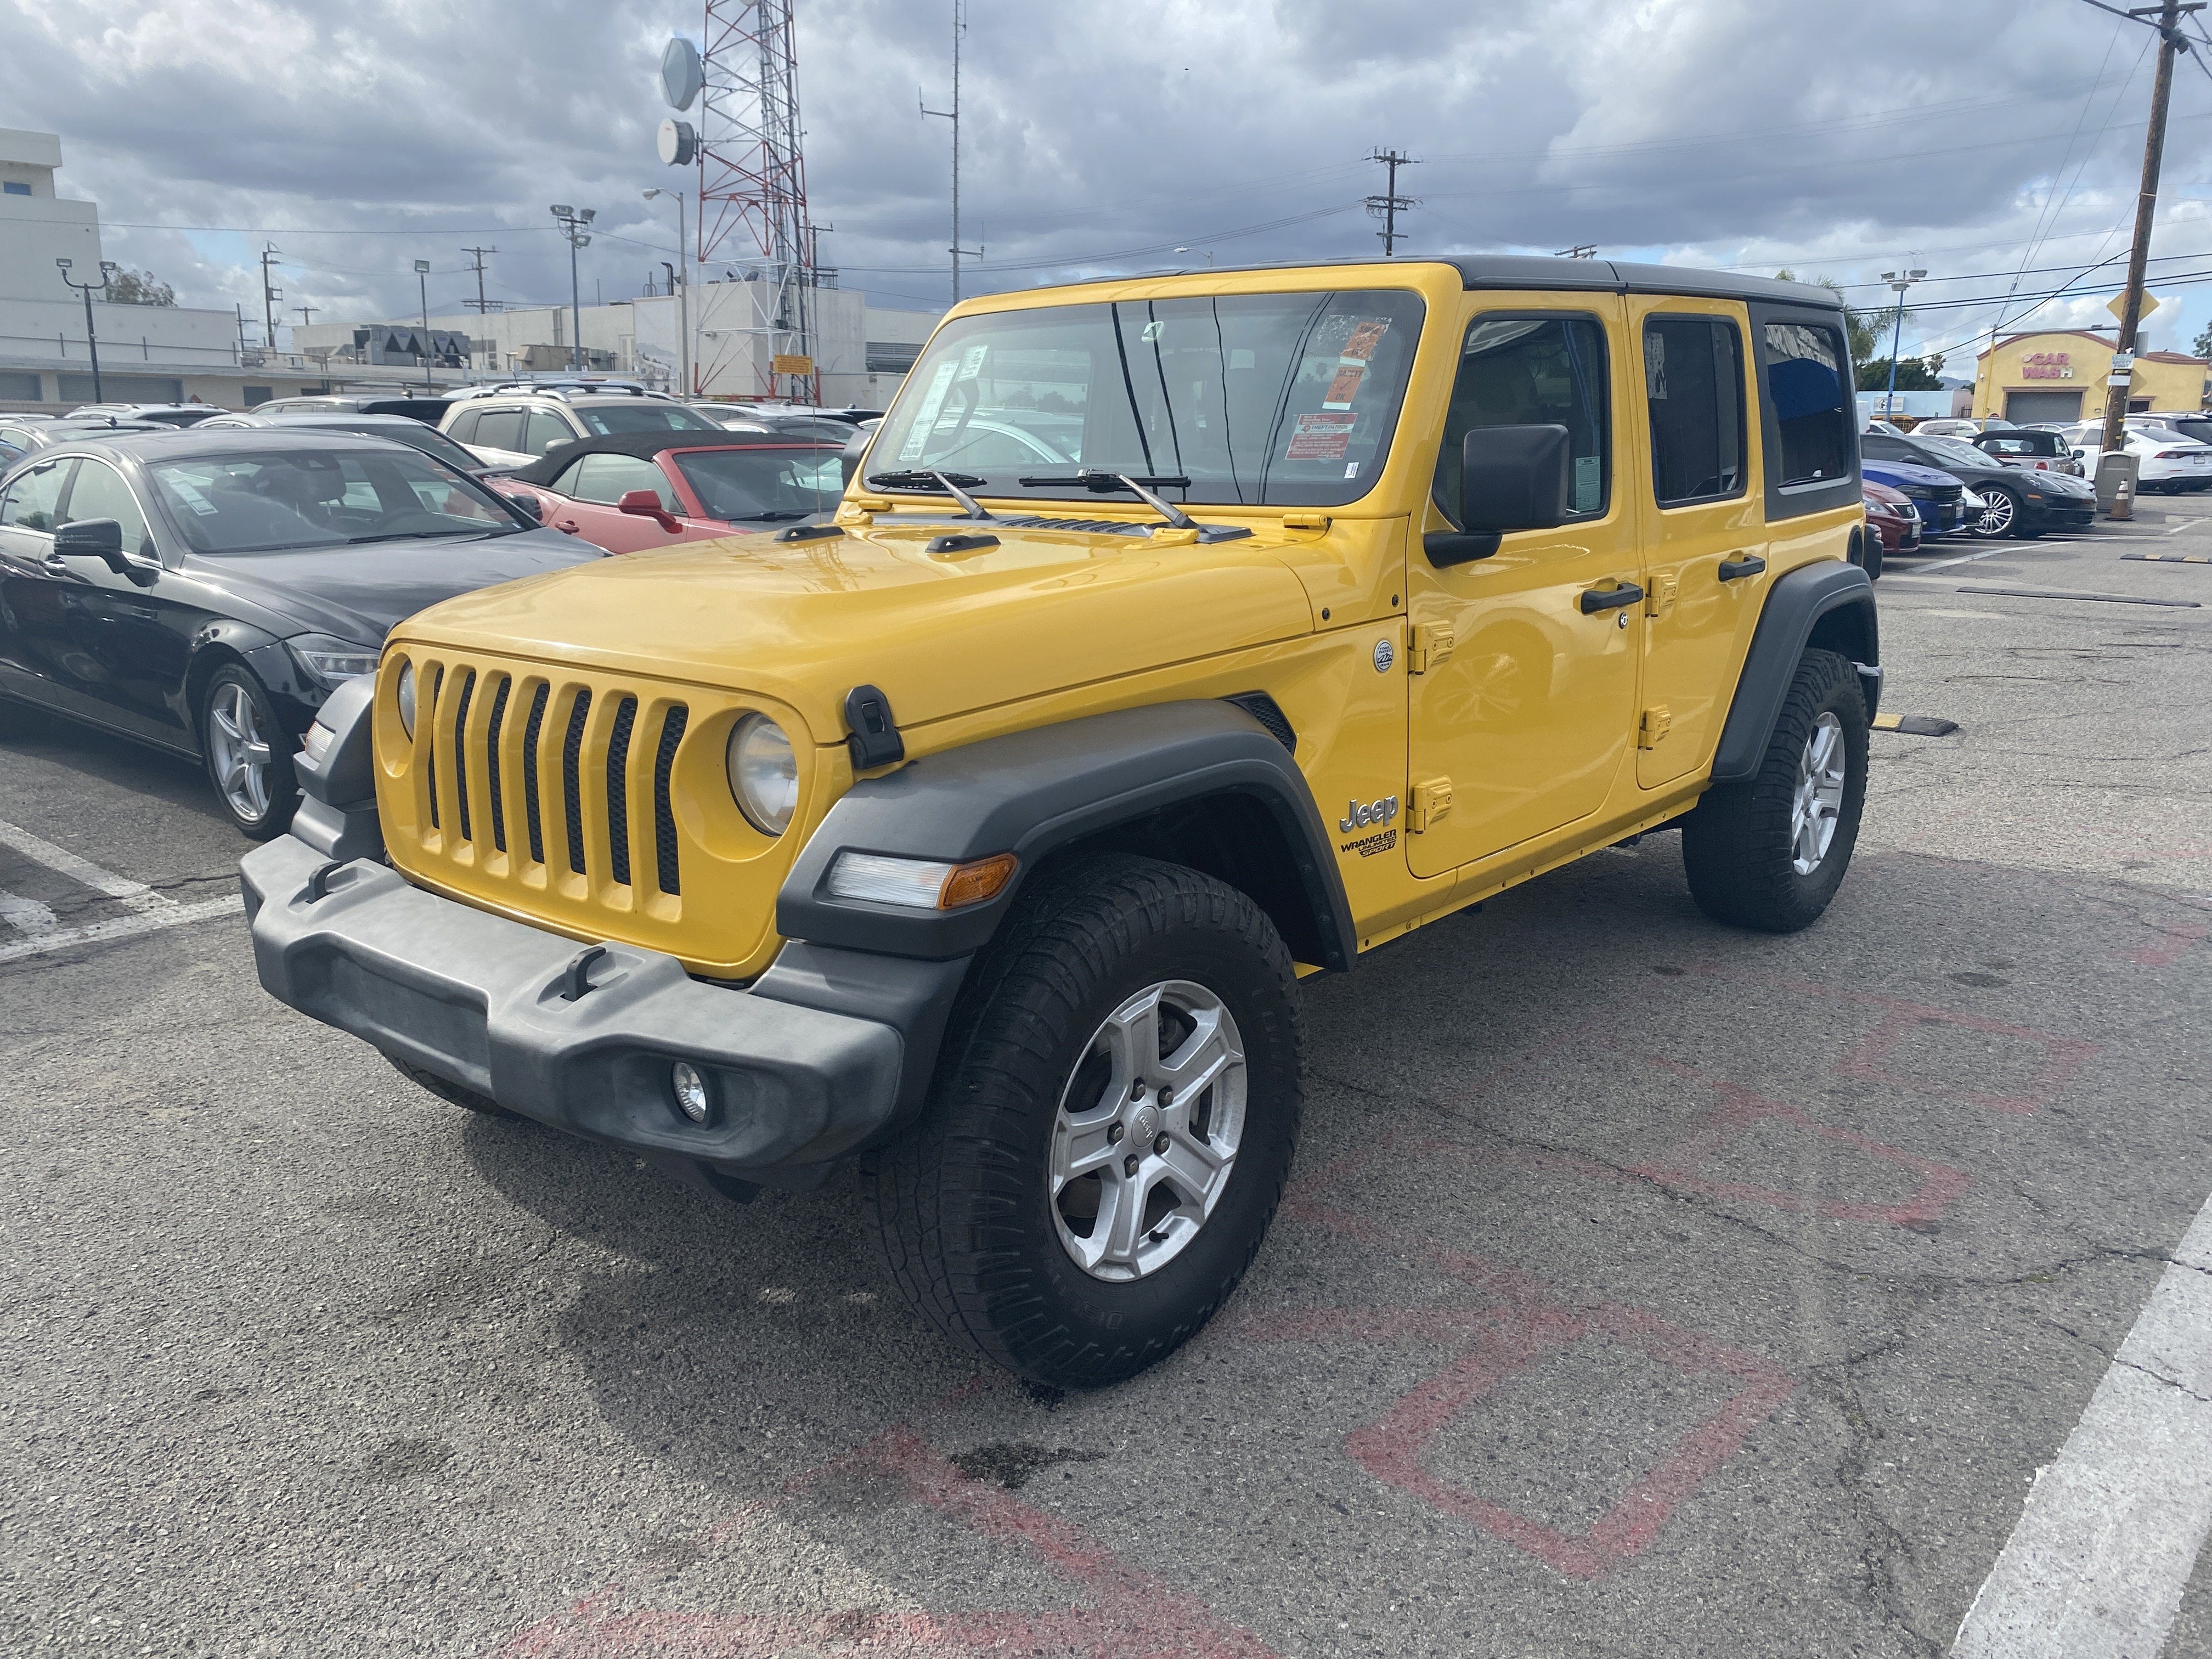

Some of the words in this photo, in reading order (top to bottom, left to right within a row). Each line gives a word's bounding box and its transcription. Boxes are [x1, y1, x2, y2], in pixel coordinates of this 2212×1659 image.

[2032, 353, 2068, 365] CAR
[1337, 370, 1364, 378] SAFETY
[2023, 366, 2073, 379] WASH
[1339, 795, 1398, 833] Jeep
[1340, 829, 1397, 853] WRANGLER
[1358, 836, 1397, 851] UNLIMITED
[1359, 842, 1395, 857] SPORT
